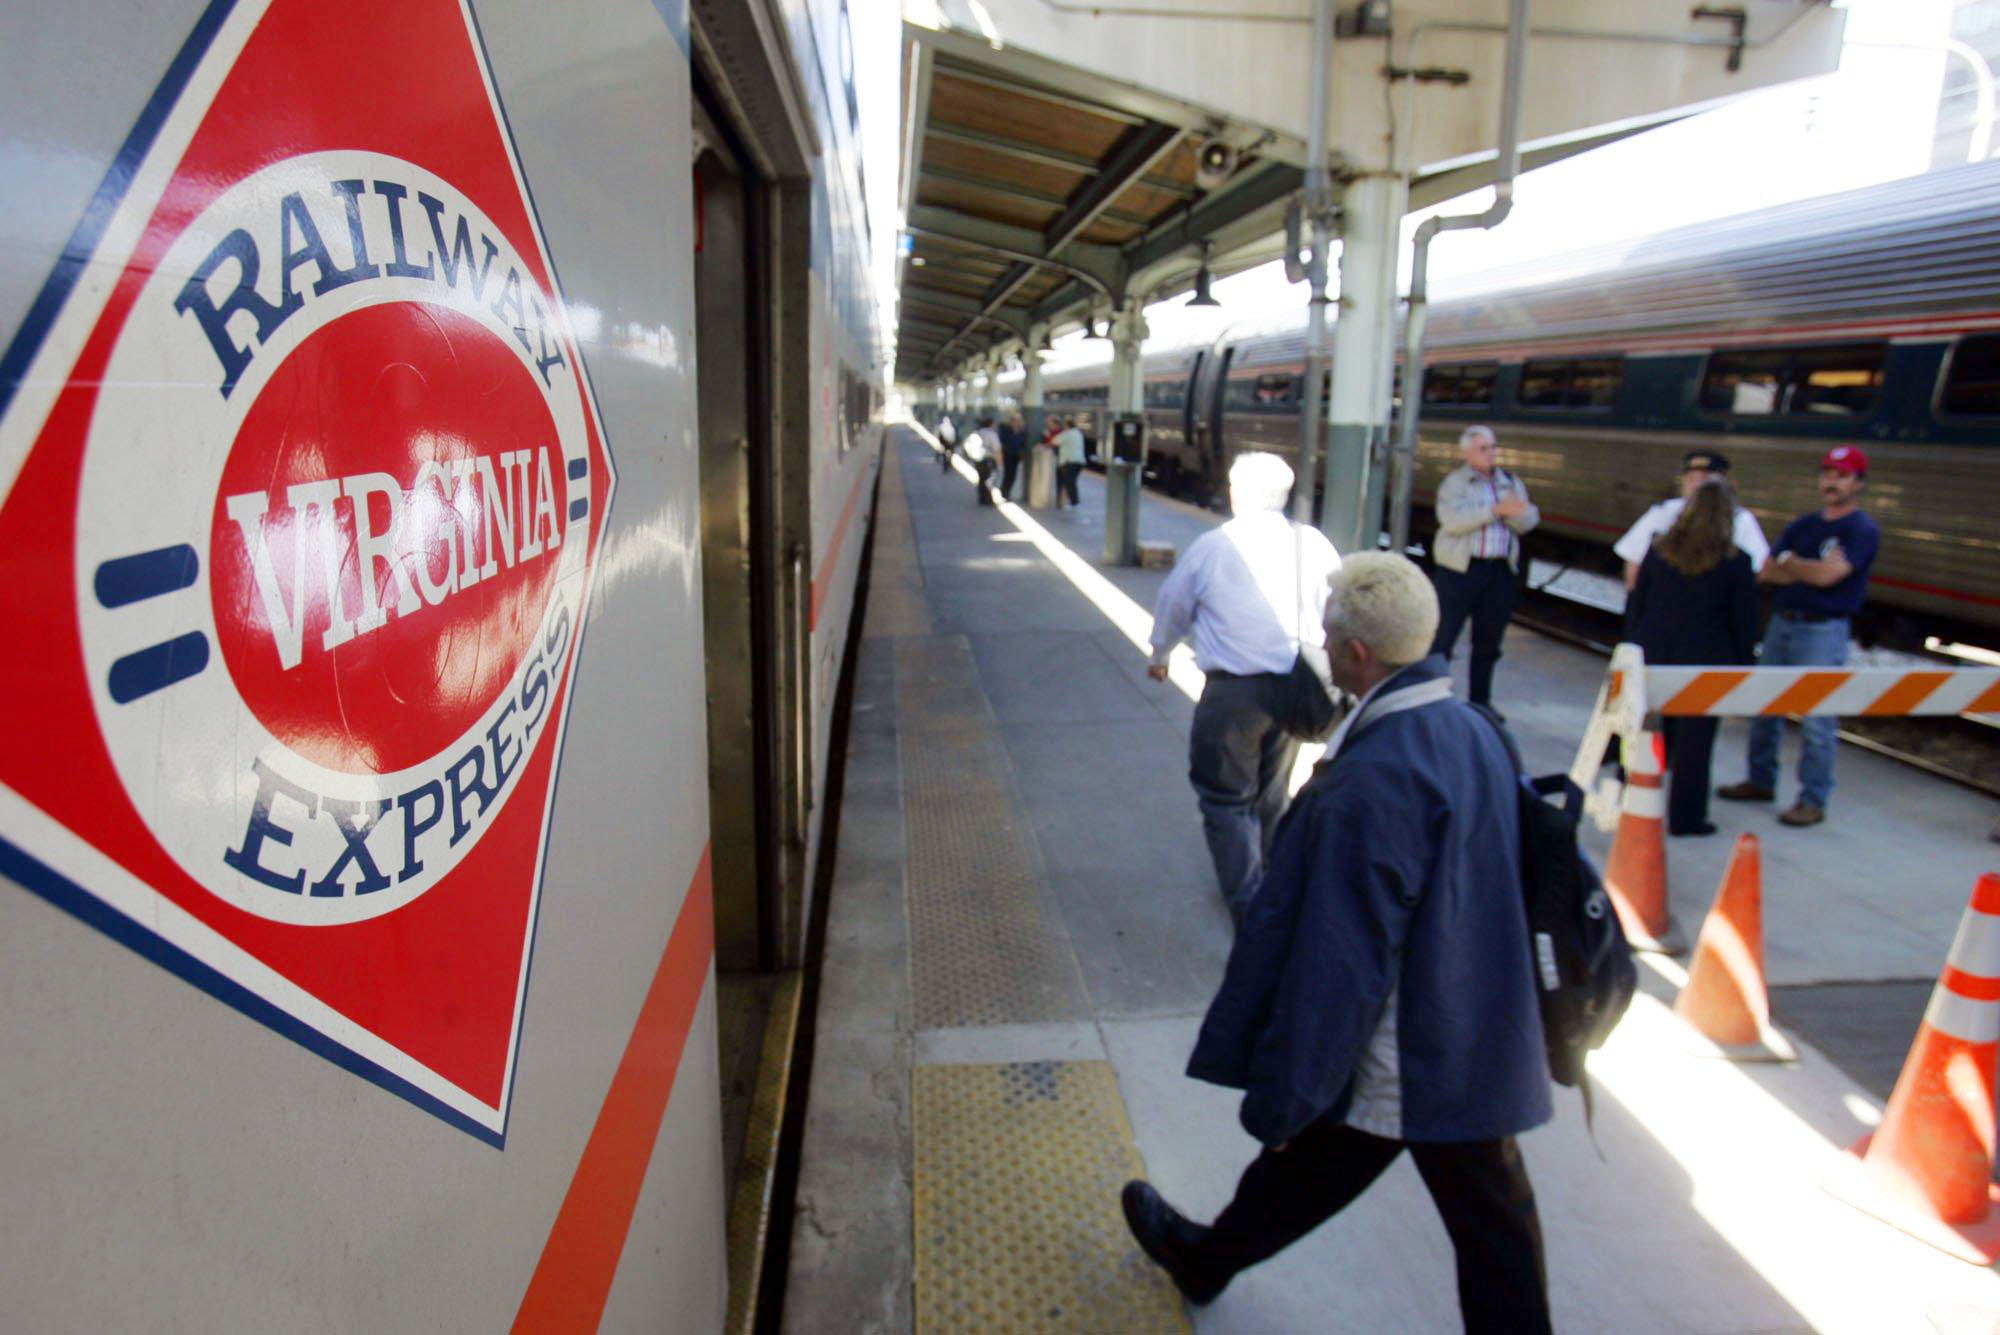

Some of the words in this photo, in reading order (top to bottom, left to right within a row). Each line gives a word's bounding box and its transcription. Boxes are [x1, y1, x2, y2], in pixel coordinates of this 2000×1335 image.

[173, 179, 566, 400] RAILWAY
[226, 445, 562, 671] VIRGINIA
[223, 589, 569, 897] EXPRESS
